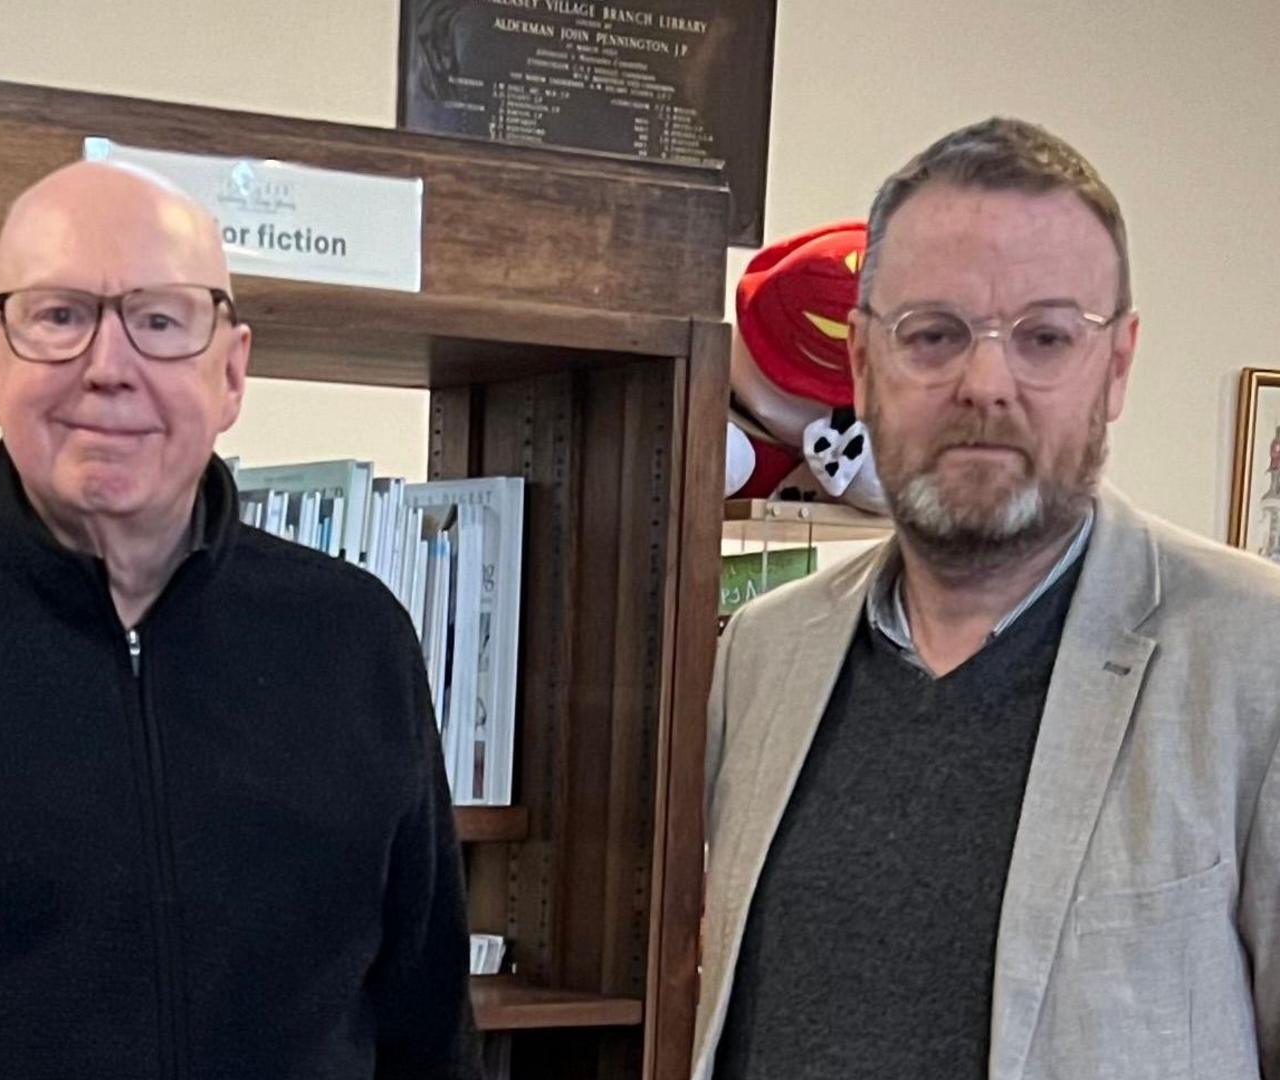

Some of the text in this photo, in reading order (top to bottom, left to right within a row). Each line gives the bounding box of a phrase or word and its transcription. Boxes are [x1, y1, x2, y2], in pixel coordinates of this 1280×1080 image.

[546, 0, 595, 18] VILLAGE
[602, 7, 654, 26] BRANCH
[658, 15, 708, 33] LIBRARY
[493, 17, 555, 38] ALDERMAN
[560, 28, 590, 42] JOHN
[595, 31, 669, 54] PENNINGTON
[257, 223, 347, 257] fiction
